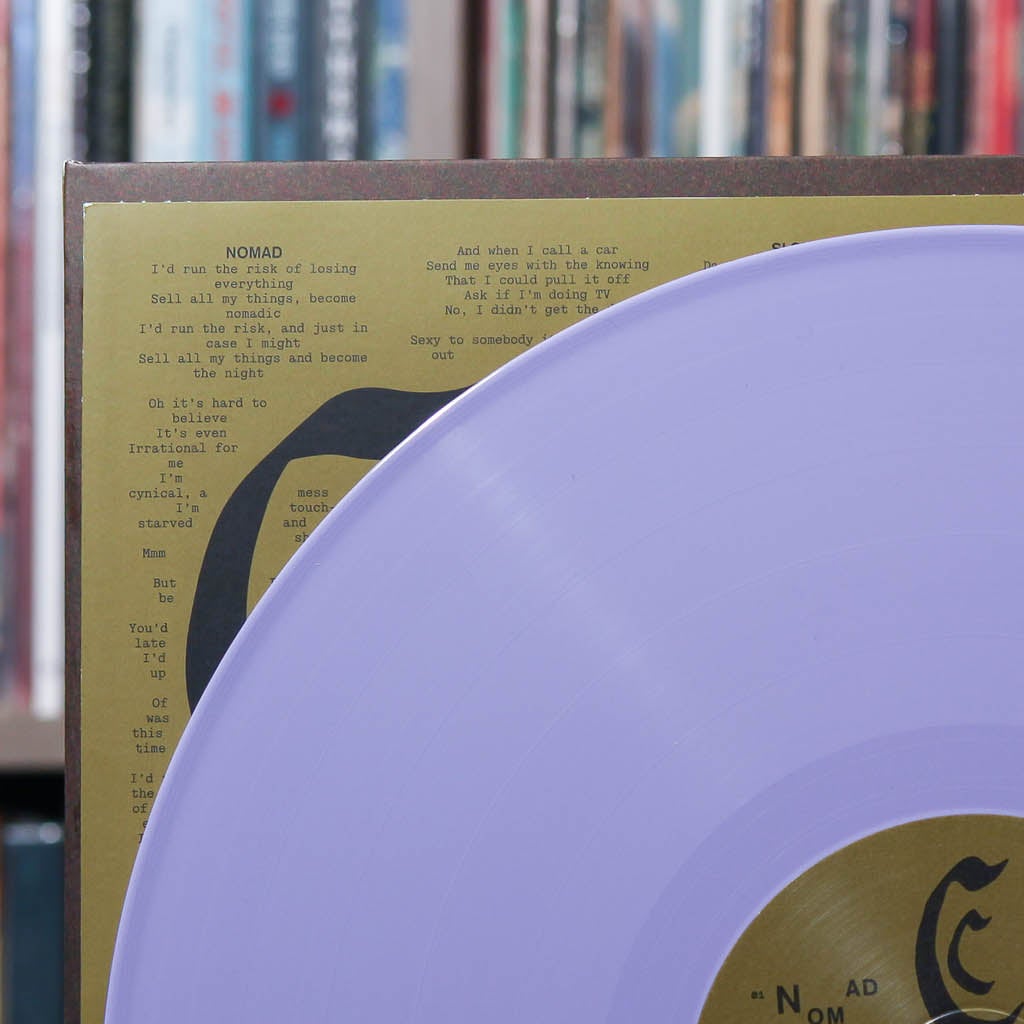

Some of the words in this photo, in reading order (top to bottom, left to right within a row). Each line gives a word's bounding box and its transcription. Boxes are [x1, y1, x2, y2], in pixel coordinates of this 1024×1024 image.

[226, 246, 283, 259] NOMAD
[457, 245, 480, 256] And
[488, 245, 519, 256] when
[526, 245, 534, 256] I
[541, 244, 573, 255] call
[580, 247, 588, 255] a
[595, 247, 619, 255] car
[151, 263, 175, 274] I'd
[183, 266, 207, 274] run
[214, 263, 239, 274] the
[246, 263, 278, 274] risk
[285, 263, 302, 274] of
[309, 263, 357, 276] losing
[426, 260, 457, 271] Send
[465, 262, 480, 271] me
[488, 262, 519, 273] eyes
[526, 259, 557, 270] with
[564, 259, 588, 270] the
[595, 259, 650, 272] knowing
[214, 278, 294, 292] everything
[445, 275, 477, 286] That
[484, 275, 492, 286] I
[499, 274, 538, 285] could
[545, 274, 577, 288] pull
[584, 274, 600, 285] it
[607, 274, 631, 285] off
[151, 293, 183, 304] Sell
[190, 293, 214, 304] all
[222, 296, 238, 307] my
[245, 293, 301, 307] things,
[309, 293, 357, 304] become
[225, 308, 281, 319] nomadic
[139, 323, 163, 334] I'd
[171, 325, 195, 334] run
[202, 322, 226, 333] the
[234, 322, 274, 335] risk,
[281, 322, 305, 333] and
[313, 322, 345, 336] just
[352, 322, 368, 333] in
[206, 340, 238, 348] case
[245, 337, 253, 348] I
[261, 337, 301, 351] might
[138, 353, 170, 364] Sell
[178, 353, 202, 364] all
[209, 355, 226, 366] my
[233, 352, 281, 366] things
[288, 352, 313, 363] and
[320, 352, 368, 363] become
[193, 367, 217, 378] the
[224, 367, 264, 381] night
[148, 398, 165, 409] Oh
[172, 398, 204, 409] it's
[212, 397, 244, 408] hard
[251, 397, 267, 408] to
[172, 412, 228, 423] believe
[156, 427, 188, 438] It's
[195, 430, 227, 438] even
[128, 442, 207, 453] Irrational
[215, 442, 239, 453] for
[297, 490, 329, 498] mess
[138, 517, 193, 528] starved
